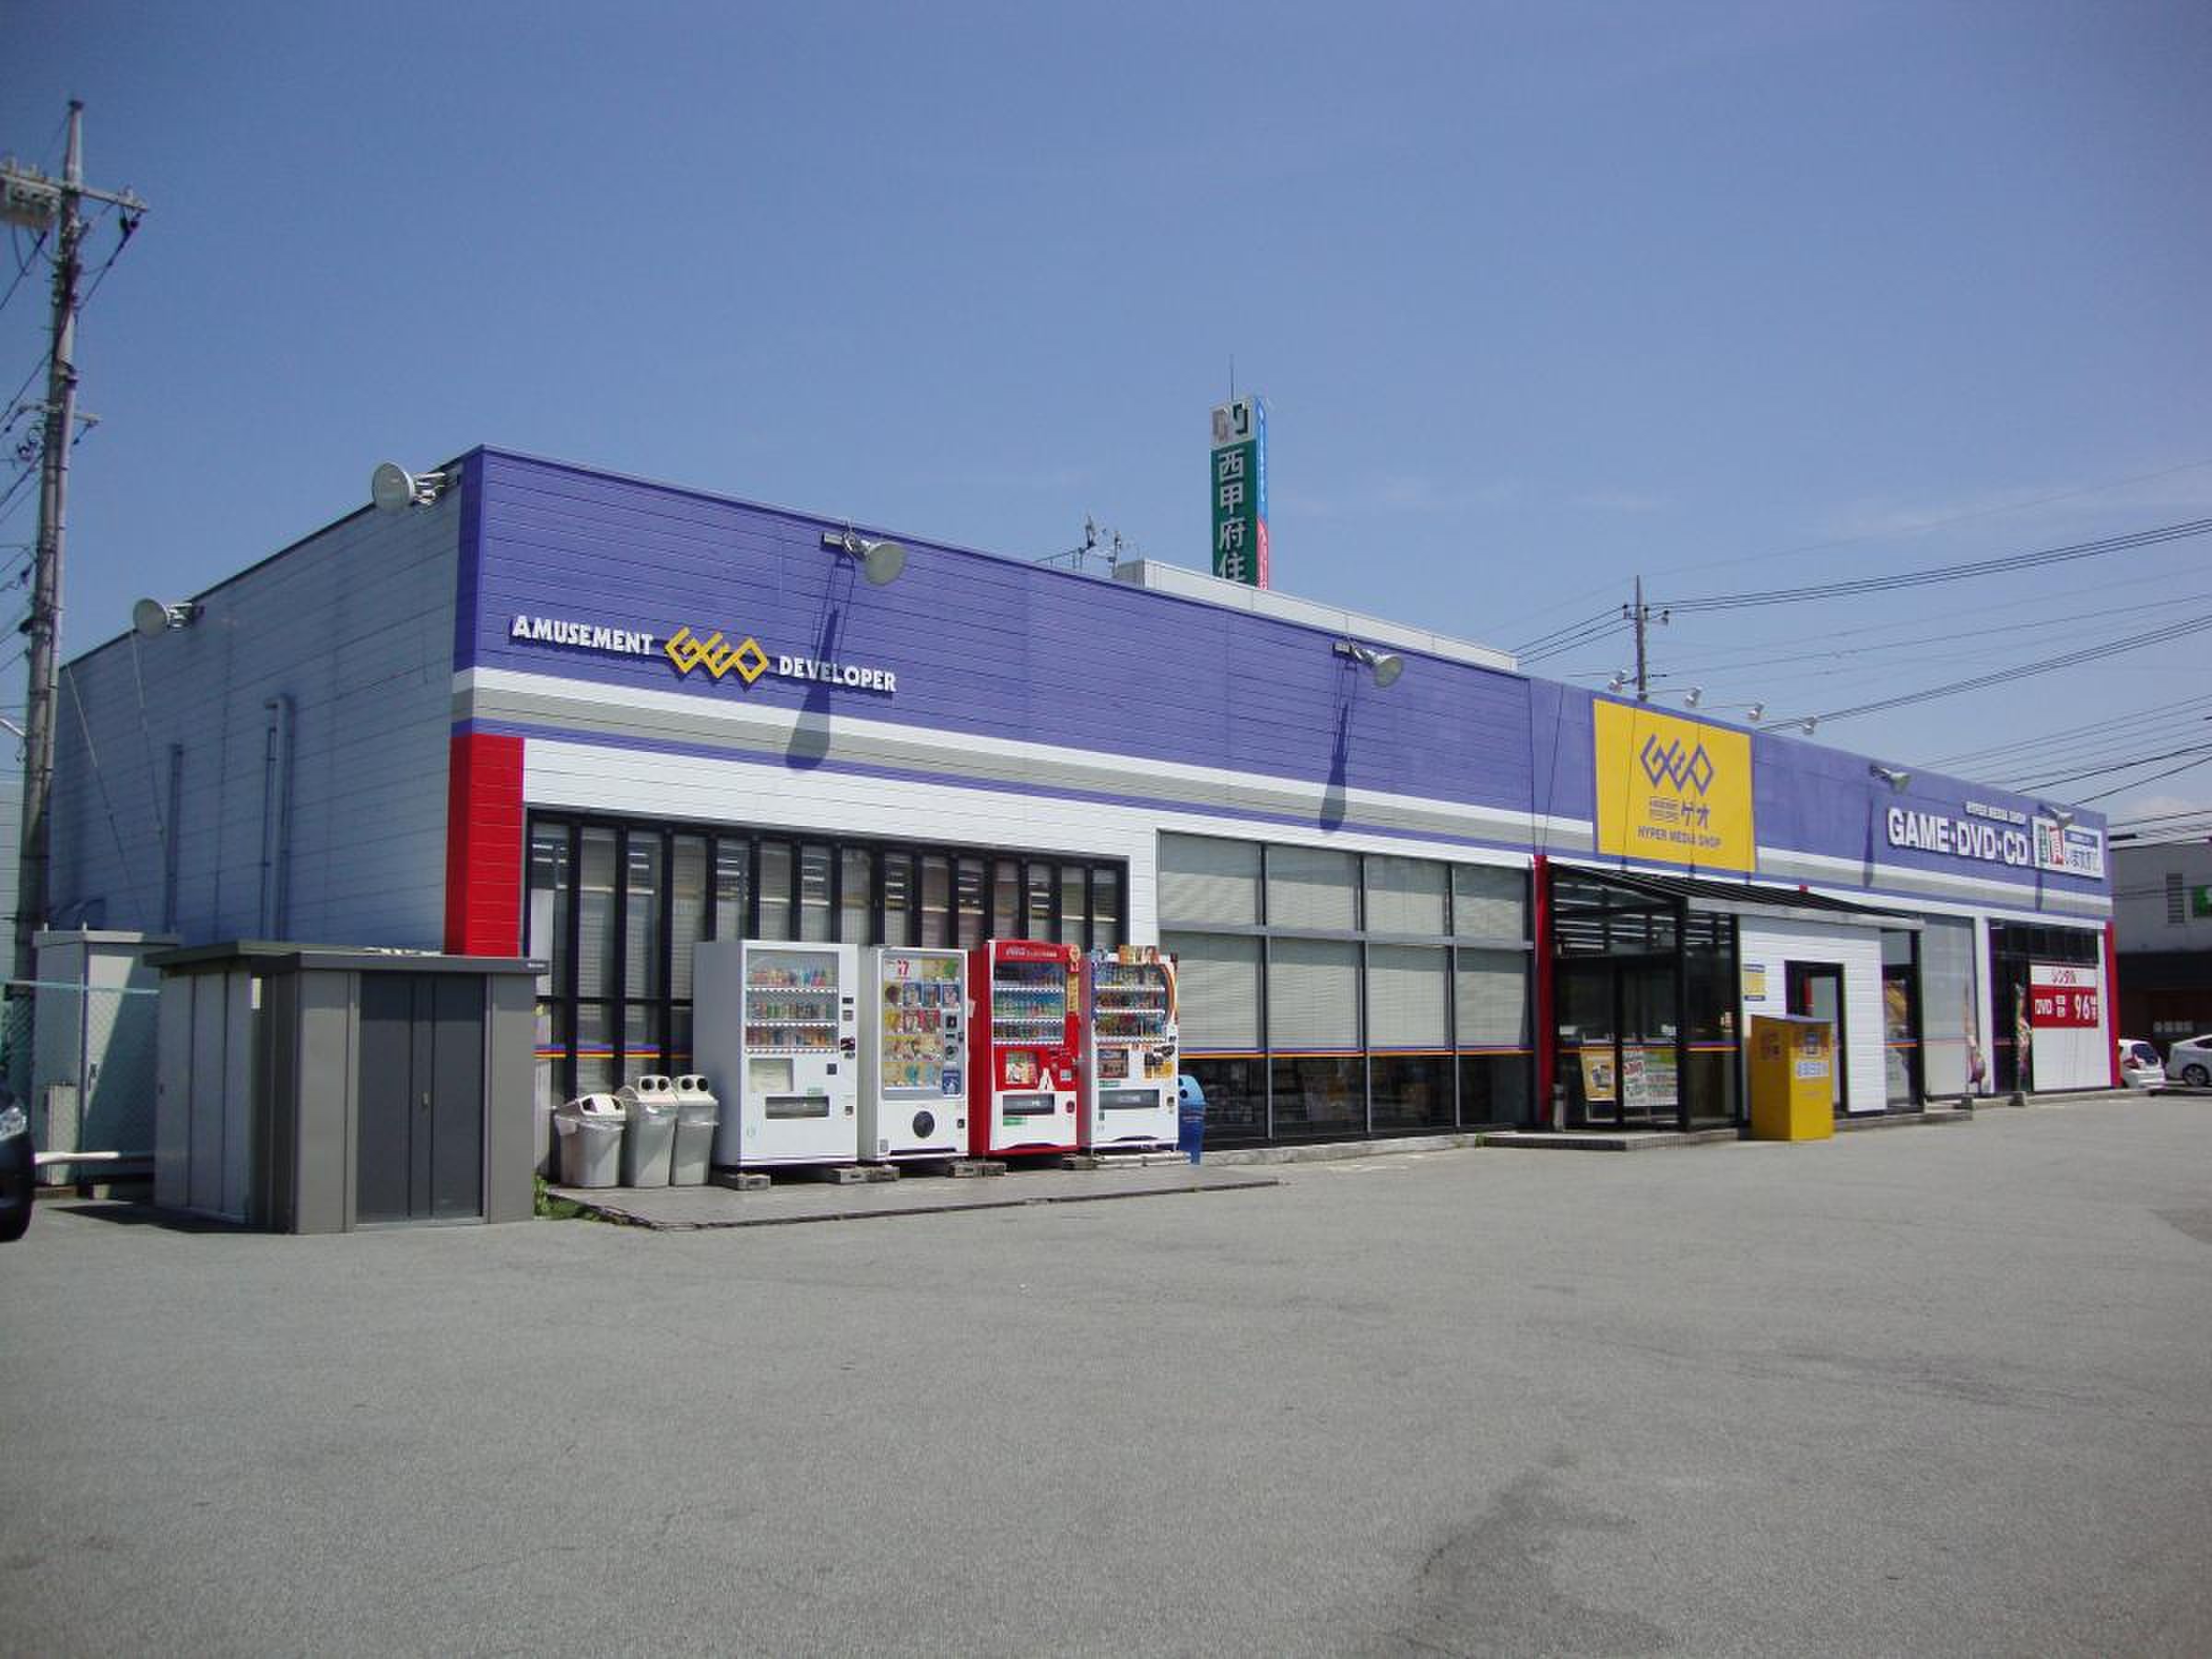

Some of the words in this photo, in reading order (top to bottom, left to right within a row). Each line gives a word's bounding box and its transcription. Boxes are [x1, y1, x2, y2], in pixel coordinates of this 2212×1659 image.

[512, 615, 654, 655] AMUSEMENT
[779, 655, 897, 692] DEVELOPER
[1638, 826, 1667, 841] HYPER
